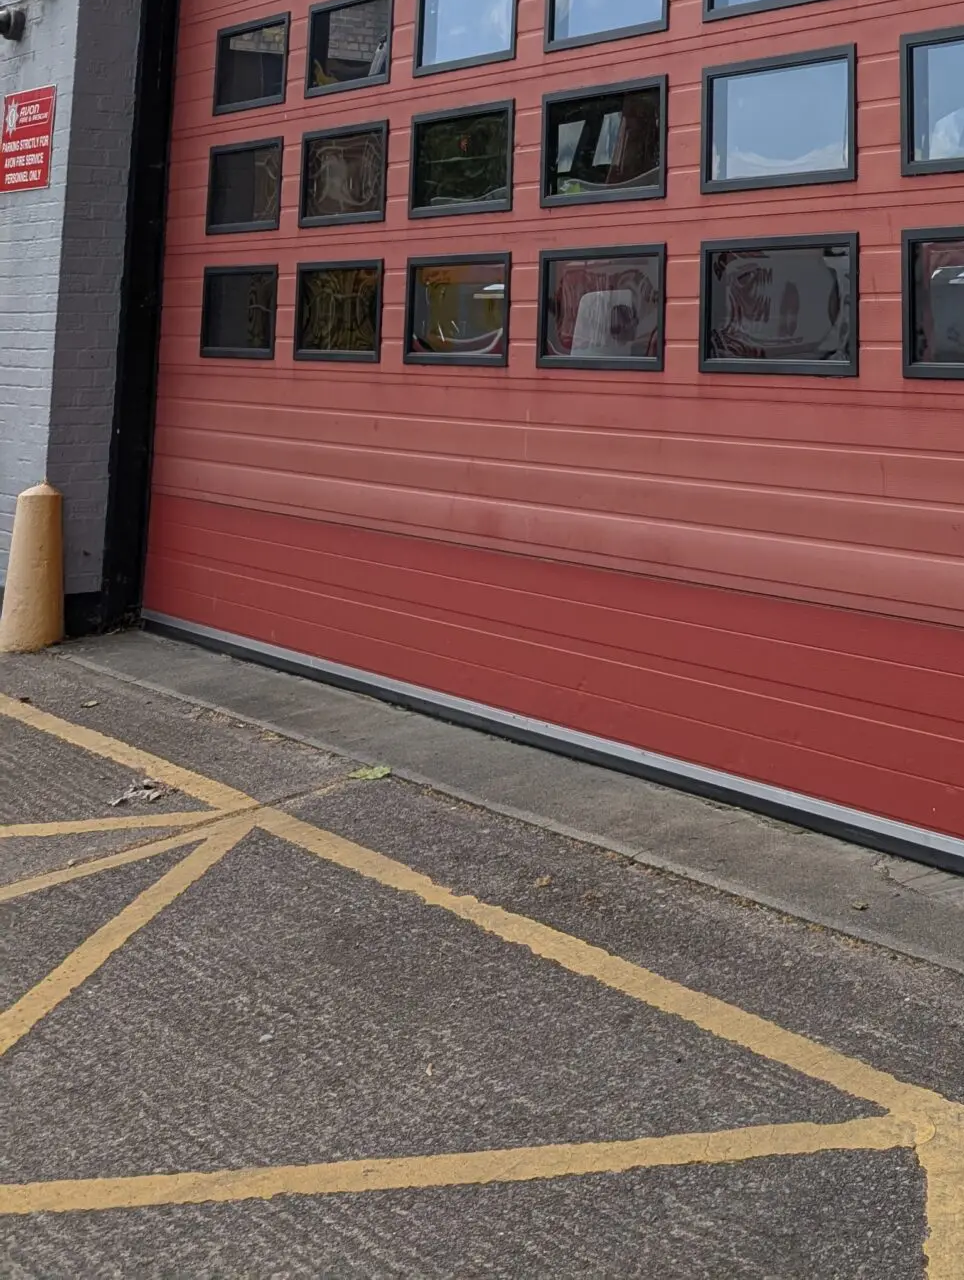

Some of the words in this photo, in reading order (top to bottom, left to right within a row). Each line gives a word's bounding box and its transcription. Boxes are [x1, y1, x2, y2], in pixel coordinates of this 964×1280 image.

[20, 104, 39, 117] AVON
[2, 140, 20, 153] PARKING
[20, 137, 39, 150] STRICTLY
[40, 135, 49, 146] FOR
[26, 153, 44, 165] SERVICE
[5, 171, 28, 184] PERSONNEL
[29, 169, 41, 181] ONLY
